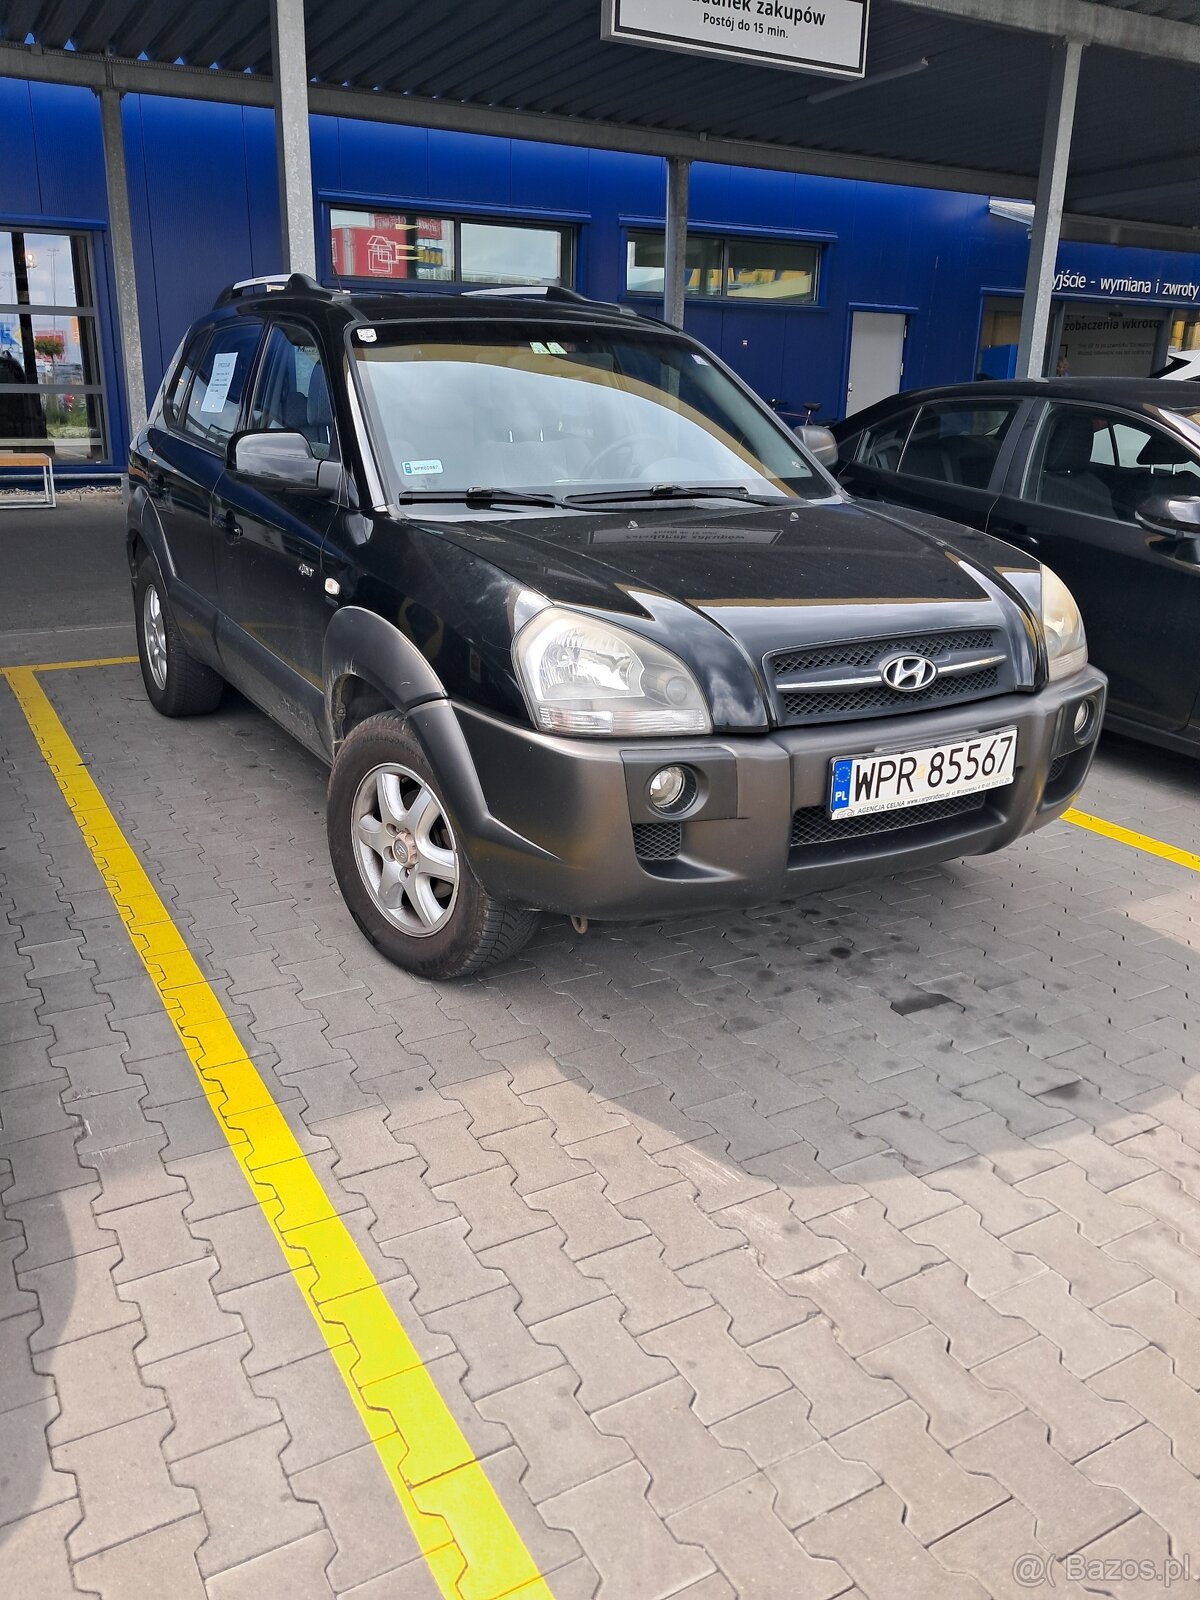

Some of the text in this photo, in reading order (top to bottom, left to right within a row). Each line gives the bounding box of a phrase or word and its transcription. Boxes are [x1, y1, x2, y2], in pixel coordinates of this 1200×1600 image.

[703, 12, 788, 38] Postój do 15 min.
[756, 0, 826, 26] zakupów
[1052, 269, 1086, 290] yjście
[1100, 277, 1151, 294] wymiana
[1155, 279, 1160, 293] i
[1162, 282, 1199, 300] zwroty
[854, 735, 1014, 802] WPR 85567
[834, 790, 848, 802] PL
[857, 804, 885, 815] AGENCJA
[886, 800, 905, 809] CELNA
